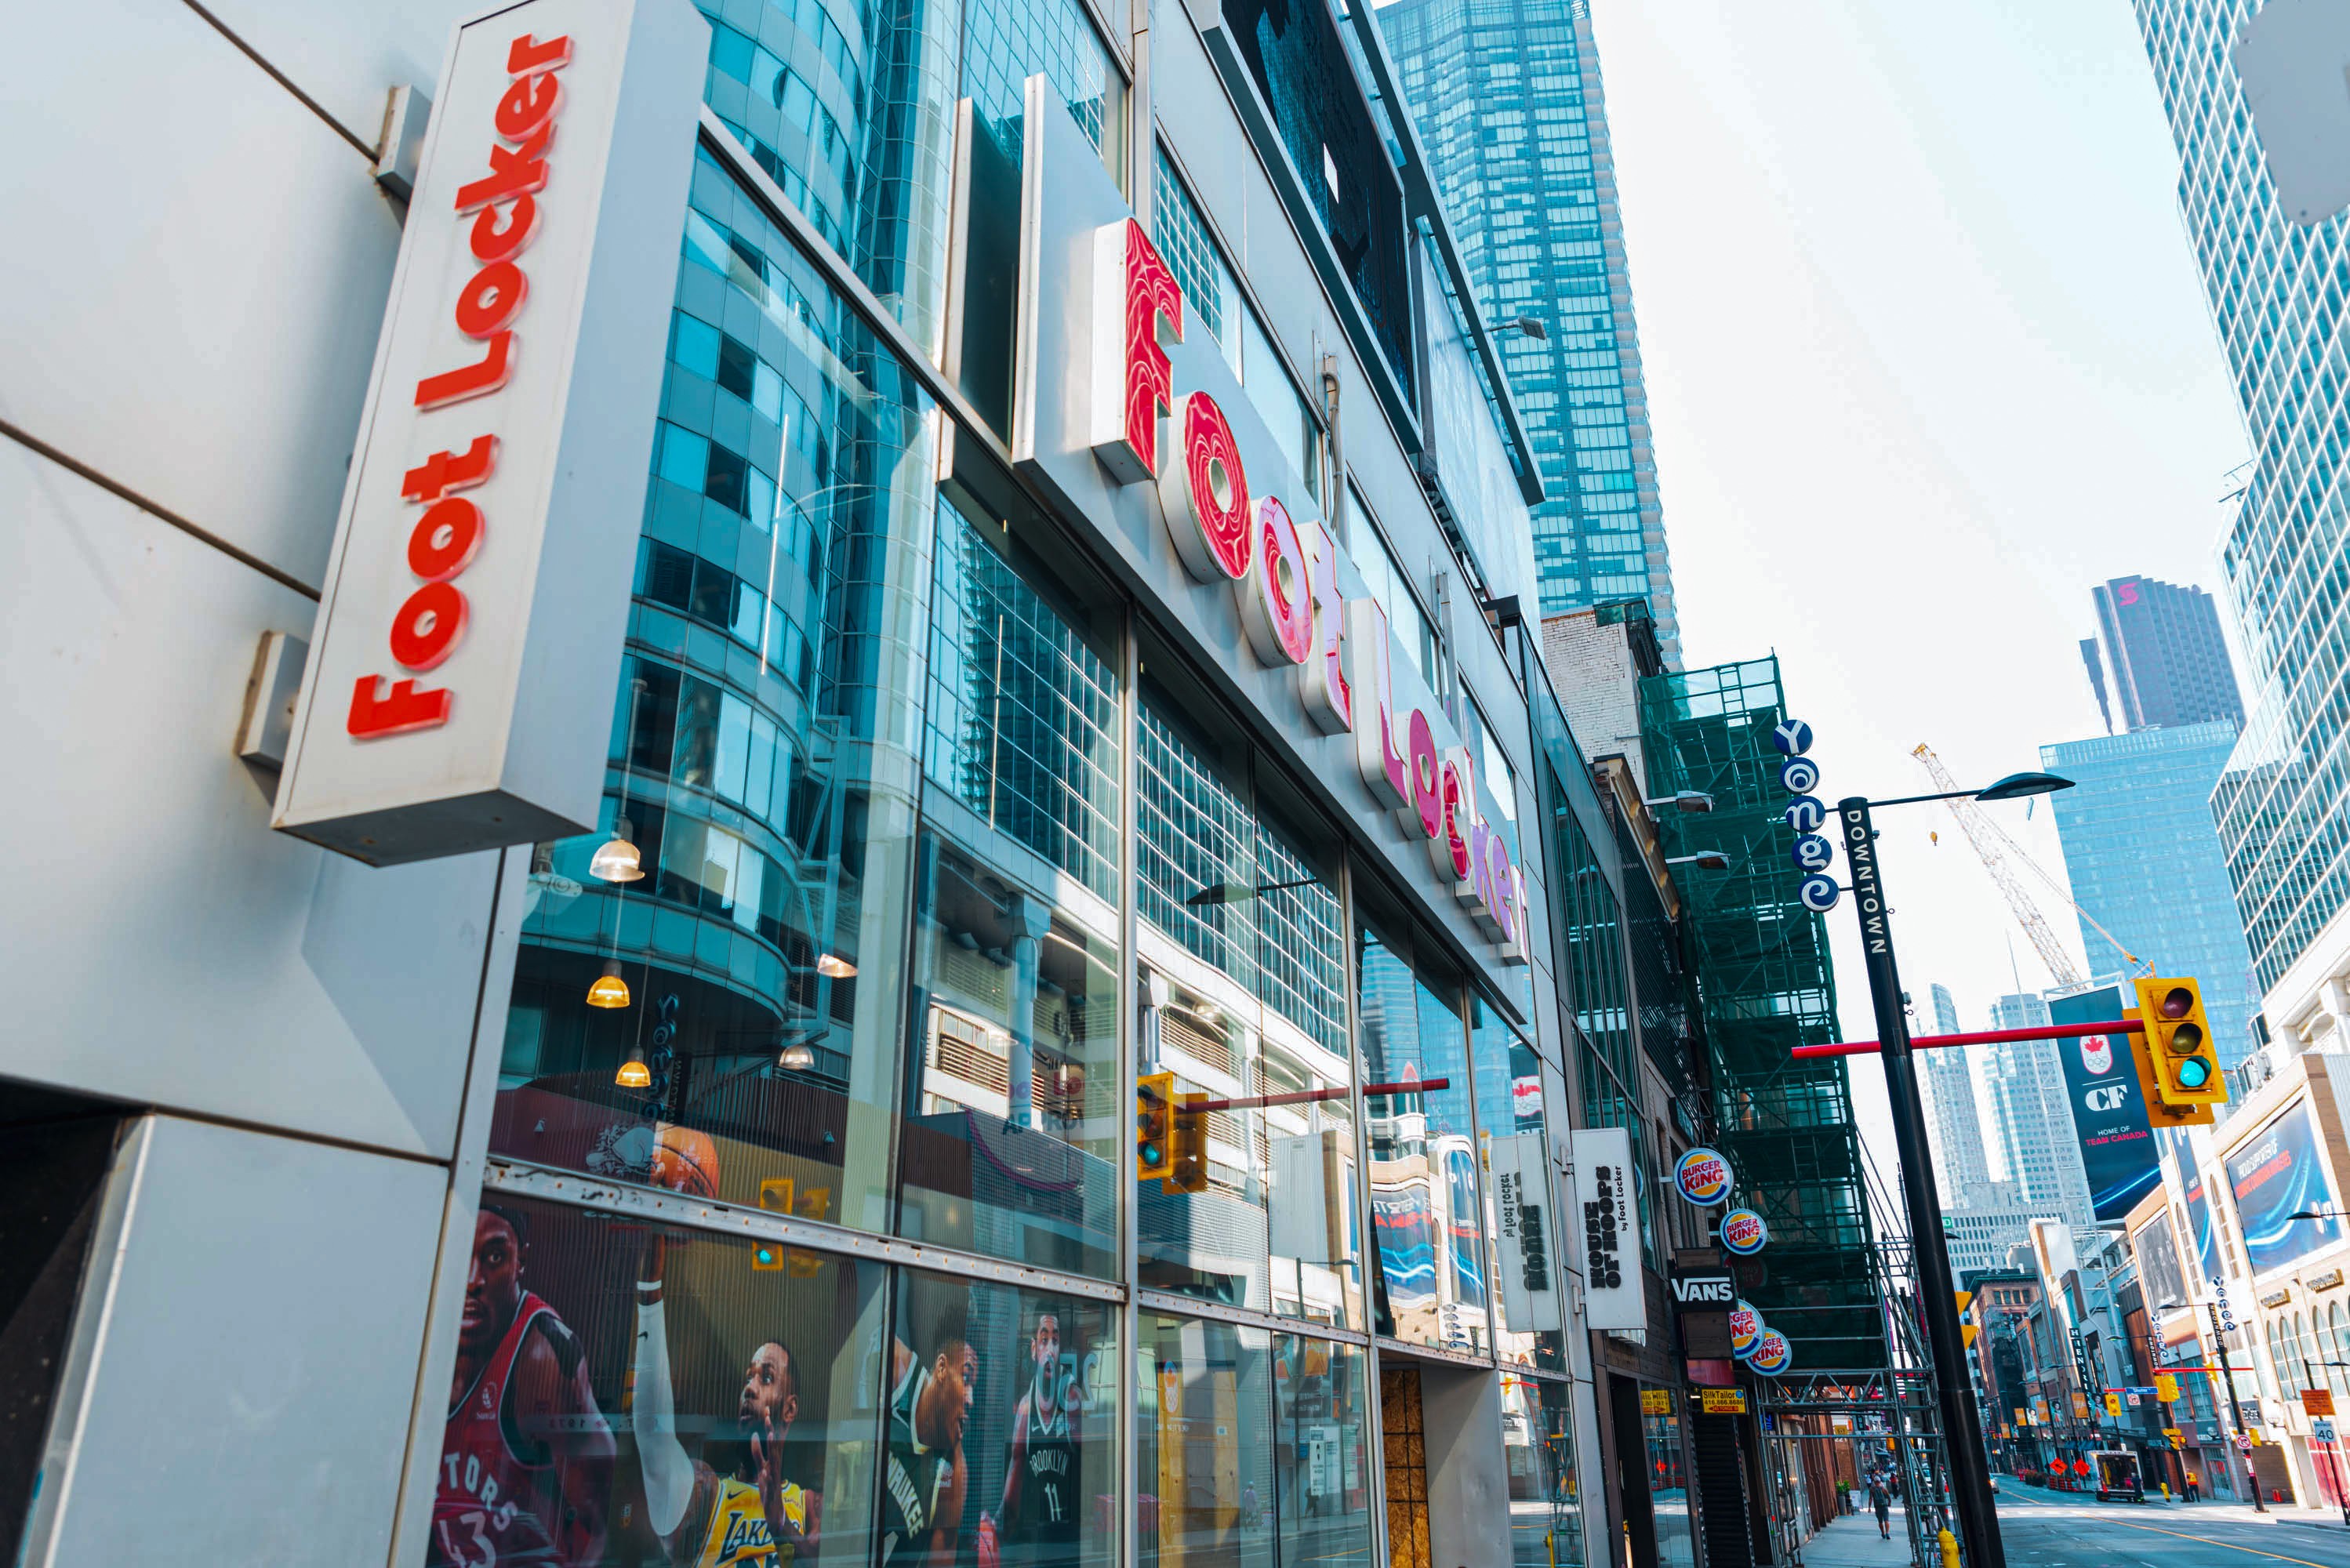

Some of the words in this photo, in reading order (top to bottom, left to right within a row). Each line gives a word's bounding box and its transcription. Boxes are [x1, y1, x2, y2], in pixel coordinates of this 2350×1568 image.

[415, 32, 573, 411] Locker
[347, 434, 500, 739] Foot
[1094, 217, 1353, 735] Foot
[1353, 597, 1529, 966] Locker
[1774, 719, 1840, 912] Yonge
[1847, 809, 1887, 954] DOWNTOWN
[2086, 1084, 2128, 1112] CF
[2085, 1137, 2109, 1146] TEAM
[2111, 1131, 2148, 1142] CANADA
[2098, 1127, 2118, 1136] HOME
[1614, 1167, 1624, 1198] Locker
[1682, 1160, 1720, 1180] BURGER
[1684, 1168, 1724, 1193] KING
[1596, 1166, 1618, 1251] HOOPS
[1617, 1200, 1626, 1221] Foot
[1622, 1223, 1629, 1232] by
[1727, 1218, 1758, 1233] BURGER
[1727, 1225, 1760, 1244] KING
[1584, 1202, 1607, 1289] HOUSE
[1604, 1254, 1622, 1289] OF
[1671, 1277, 1733, 1301] VANS
[1731, 1320, 1756, 1338] NG
[2318, 1429, 2334, 1440] 40
[1030, 1449, 1069, 1477] BROOKLYN
[439, 1451, 518, 1531] TORS
[1044, 1482, 1061, 1523] 11
